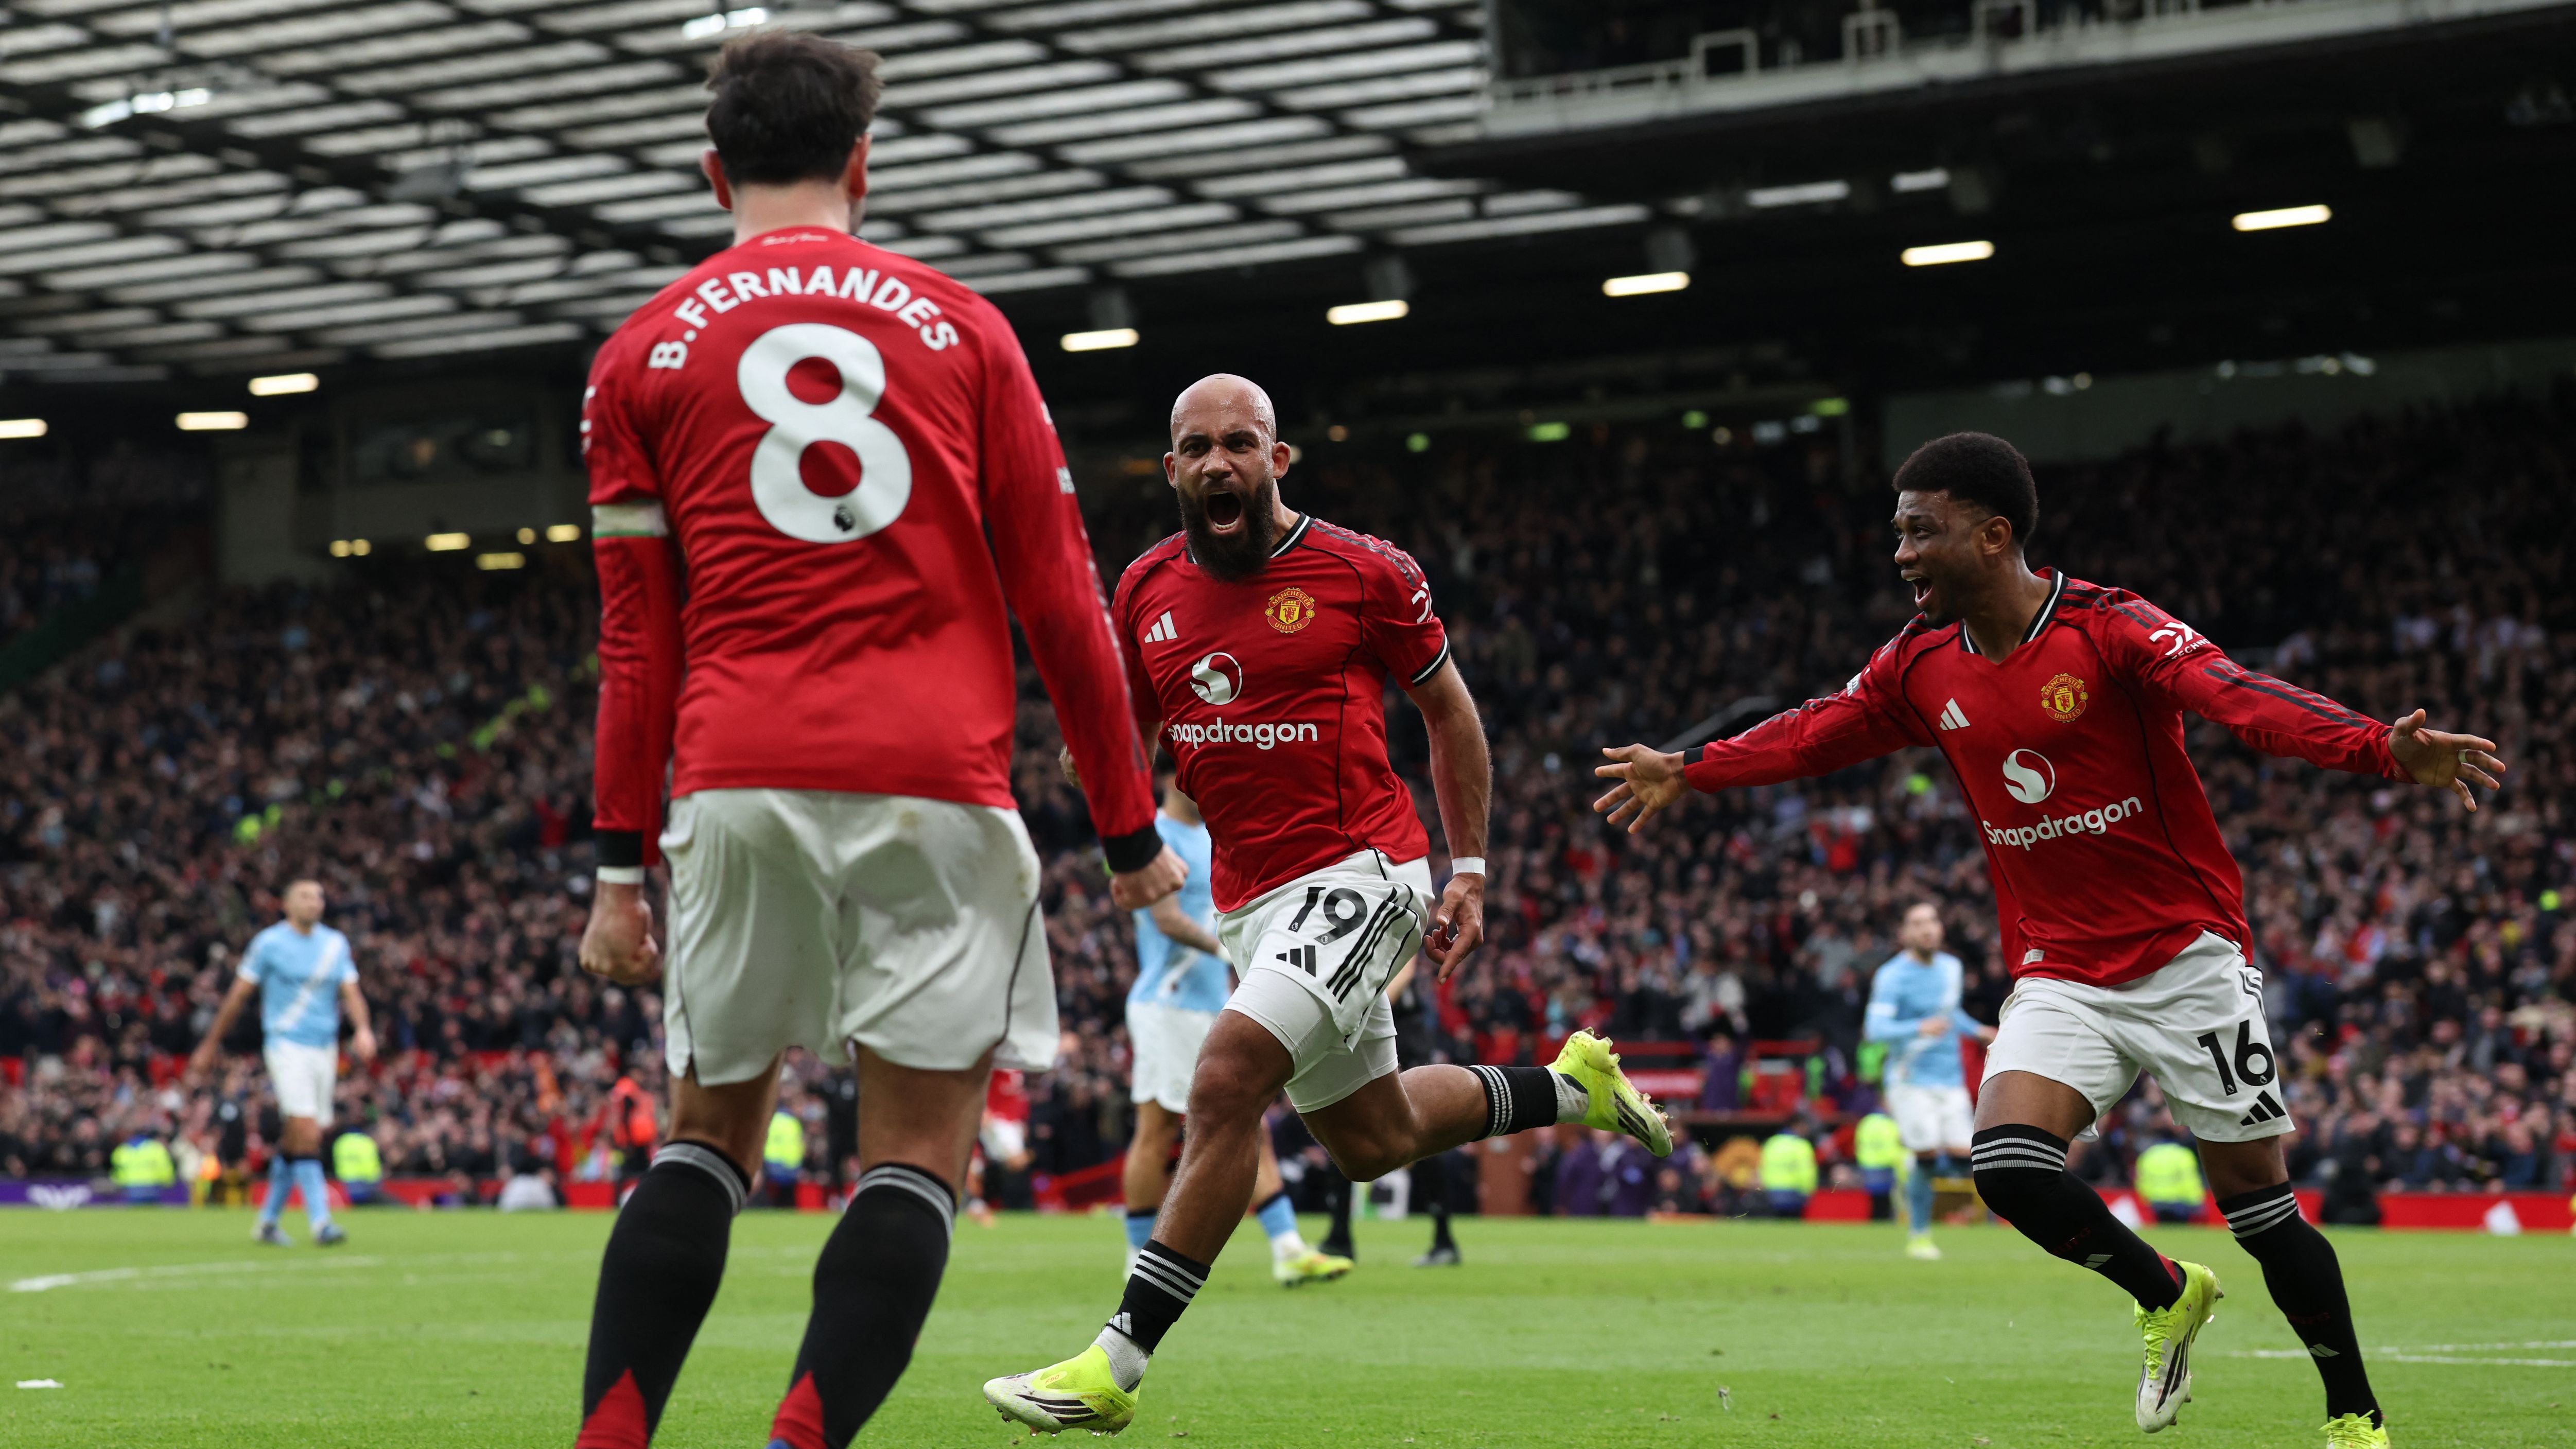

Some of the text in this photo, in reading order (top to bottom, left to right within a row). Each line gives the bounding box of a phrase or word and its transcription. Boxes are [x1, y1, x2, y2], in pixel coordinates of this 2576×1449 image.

[649, 265, 959, 369] B.FERNANDES
[738, 323, 912, 543] 8
[1272, 591, 1311, 606] MANCHESTER
[2044, 677, 2081, 695] MANCHESTER
[2055, 709, 2081, 719] UNITED
[1982, 796, 2143, 851] Snapdragon
[1288, 887, 1367, 946] 19
[2197, 1019, 2275, 1096] 16
